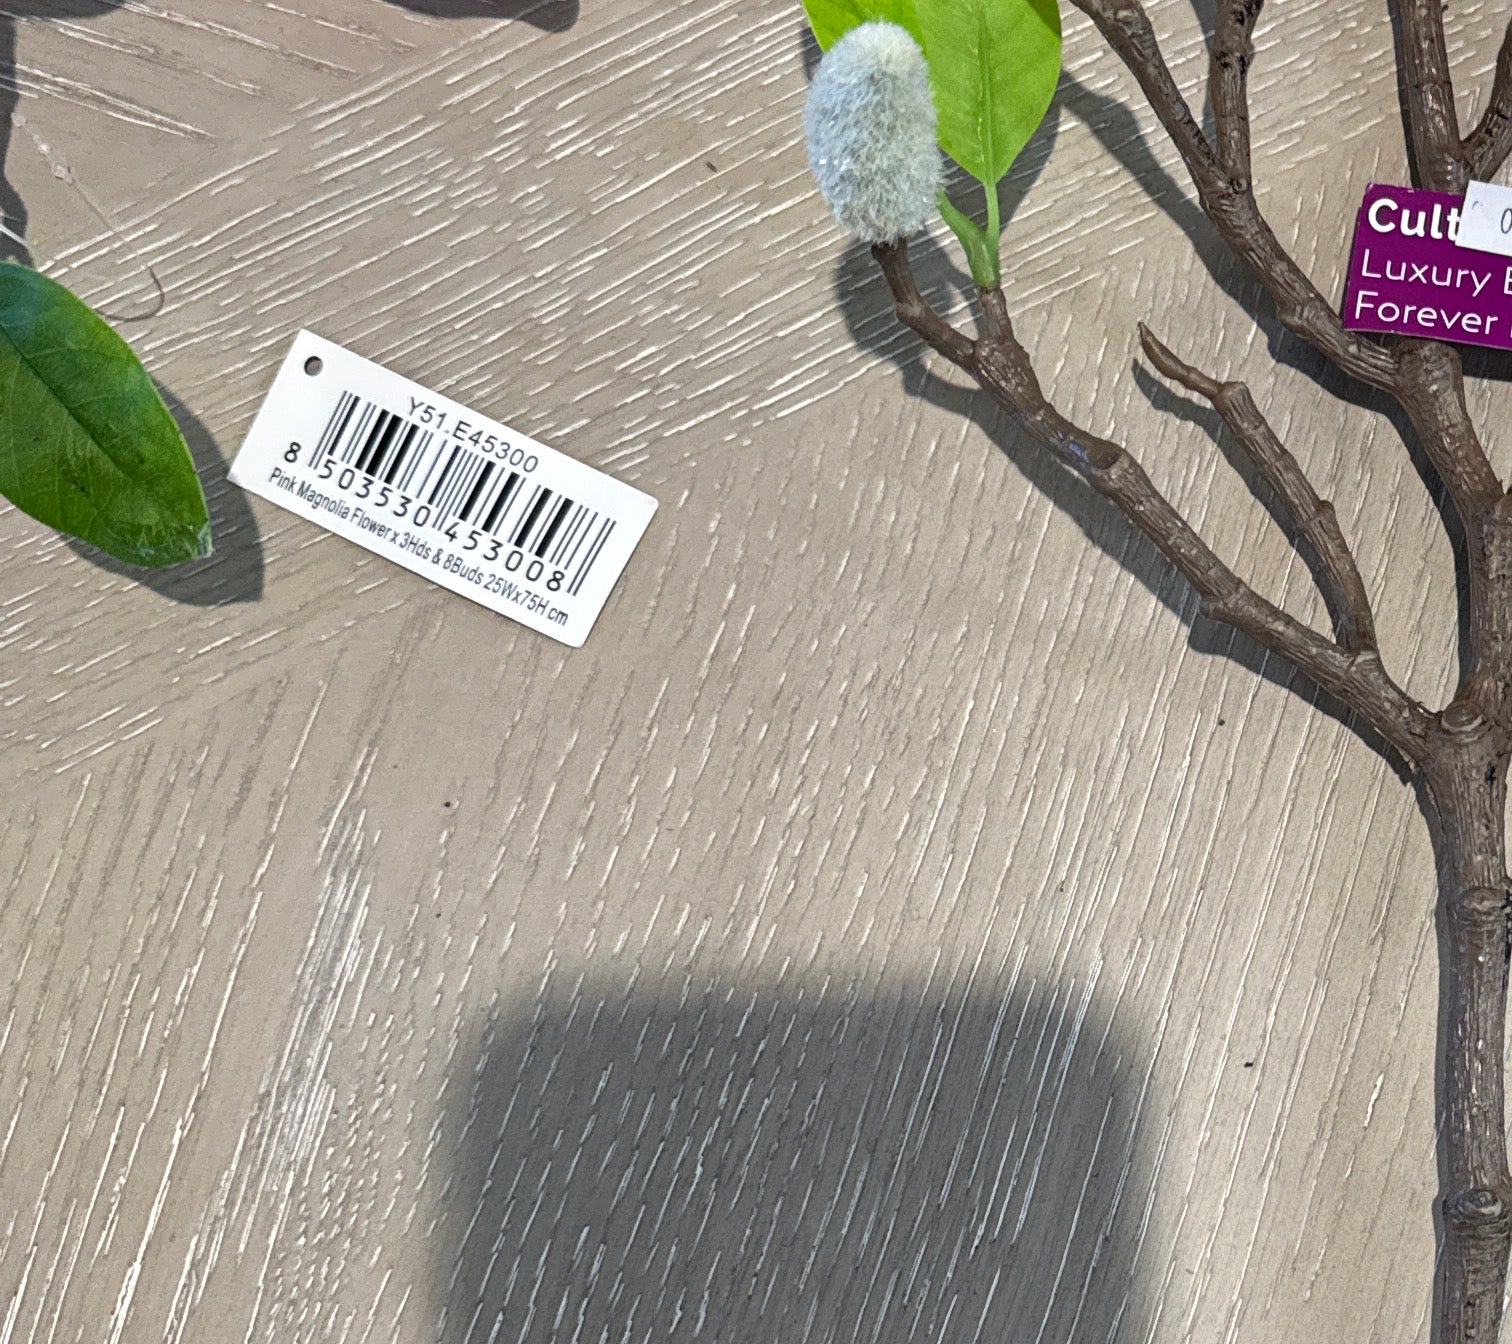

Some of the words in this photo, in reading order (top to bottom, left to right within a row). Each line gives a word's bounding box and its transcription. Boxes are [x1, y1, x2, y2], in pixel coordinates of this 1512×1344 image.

[1361, 248, 1492, 297] Luxury
[1355, 290, 1498, 335] Forever
[407, 396, 539, 473] Y51.E45300
[269, 467, 298, 493] Pink
[297, 480, 350, 519] Magnolia
[350, 507, 392, 539] Flower
[390, 531, 400, 545] x
[399, 531, 432, 560] 3Hds
[431, 548, 443, 565] &
[443, 554, 484, 585] 8Buds
[483, 573, 550, 616] 25Wx75H
[548, 607, 569, 626] cm
[284, 441, 302, 463] 8
[318, 458, 431, 527] 503530
[444, 521, 566, 592] 453008
